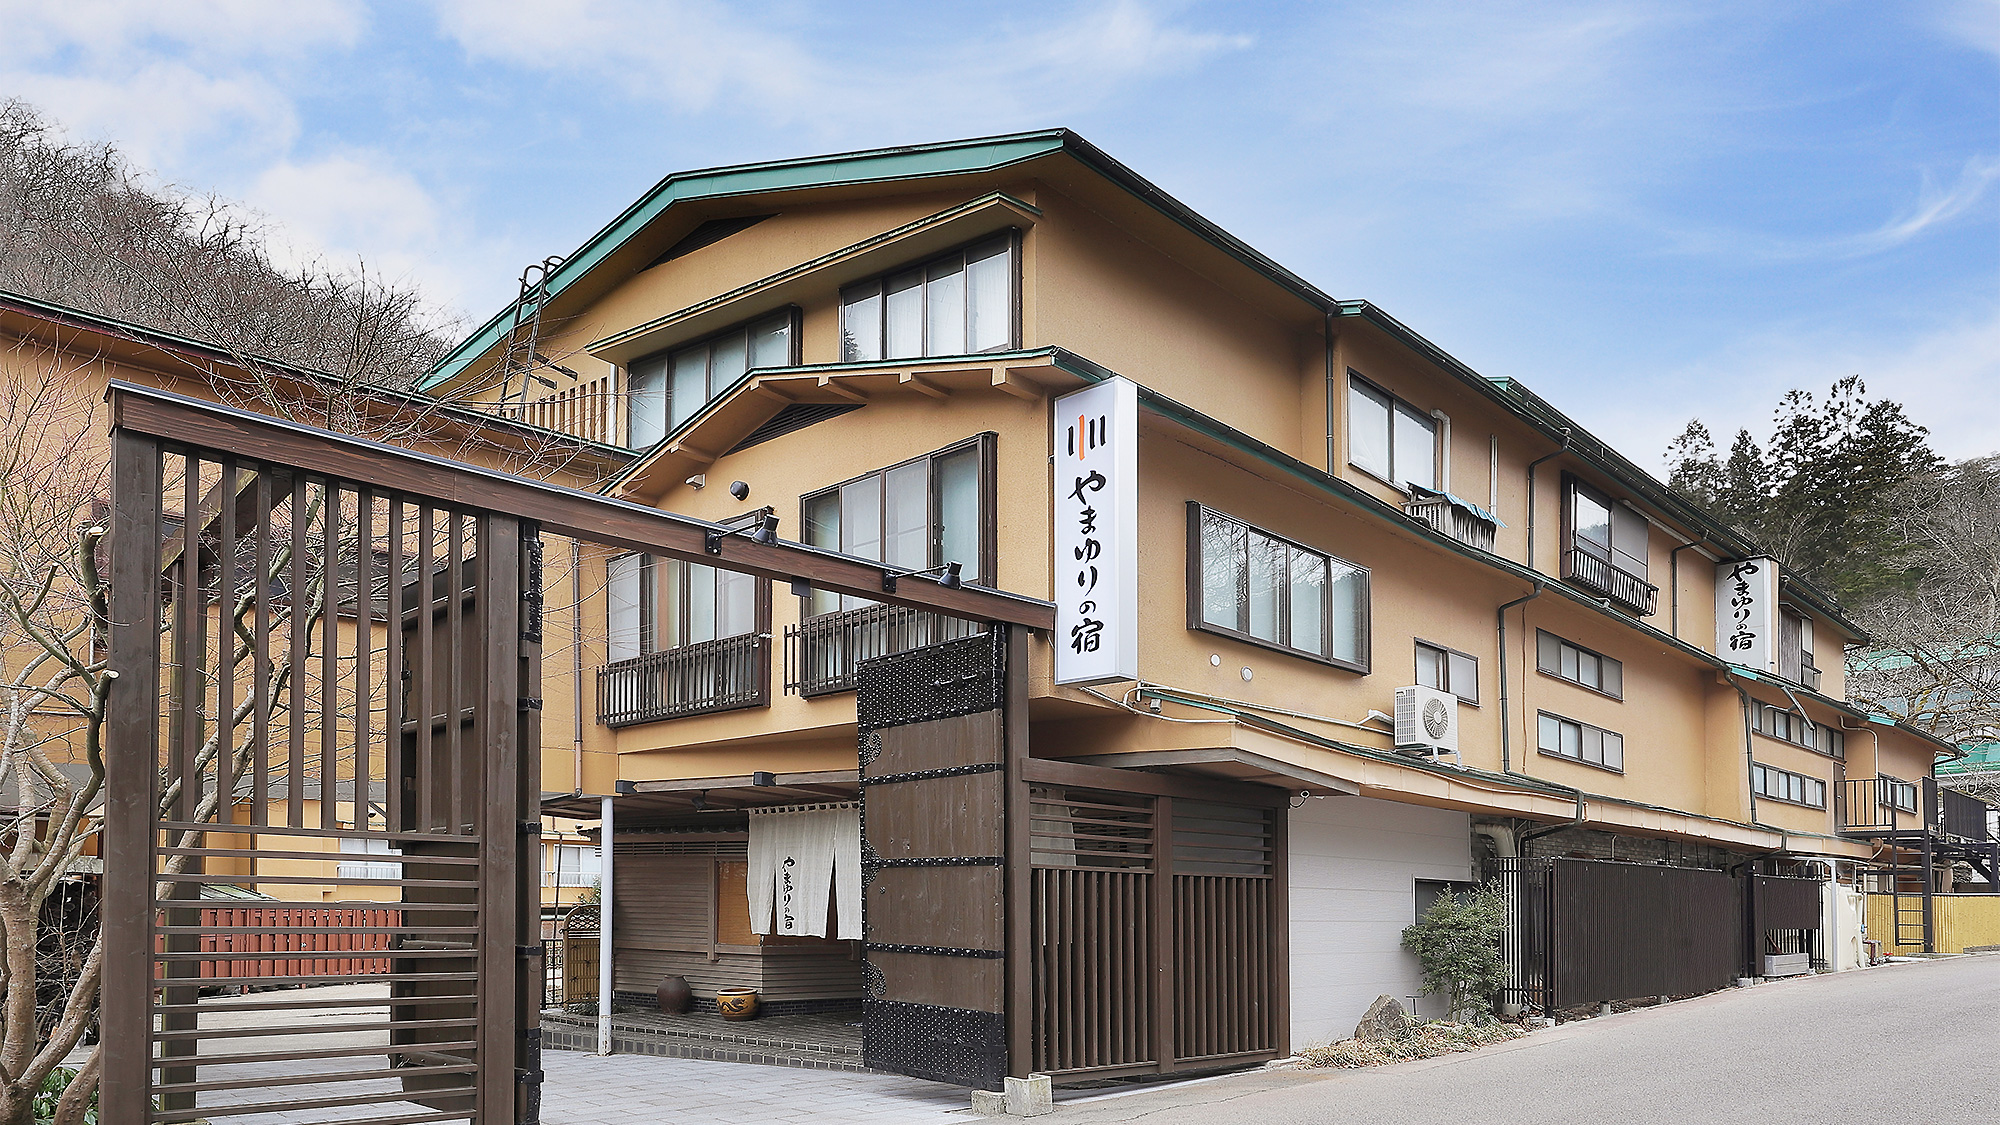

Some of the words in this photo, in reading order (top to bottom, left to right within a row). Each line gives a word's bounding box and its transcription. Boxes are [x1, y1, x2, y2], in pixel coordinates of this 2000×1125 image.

[1068, 470, 1106, 654] やまゆりの宿
[1727, 561, 1759, 651] やまゆりの宿
